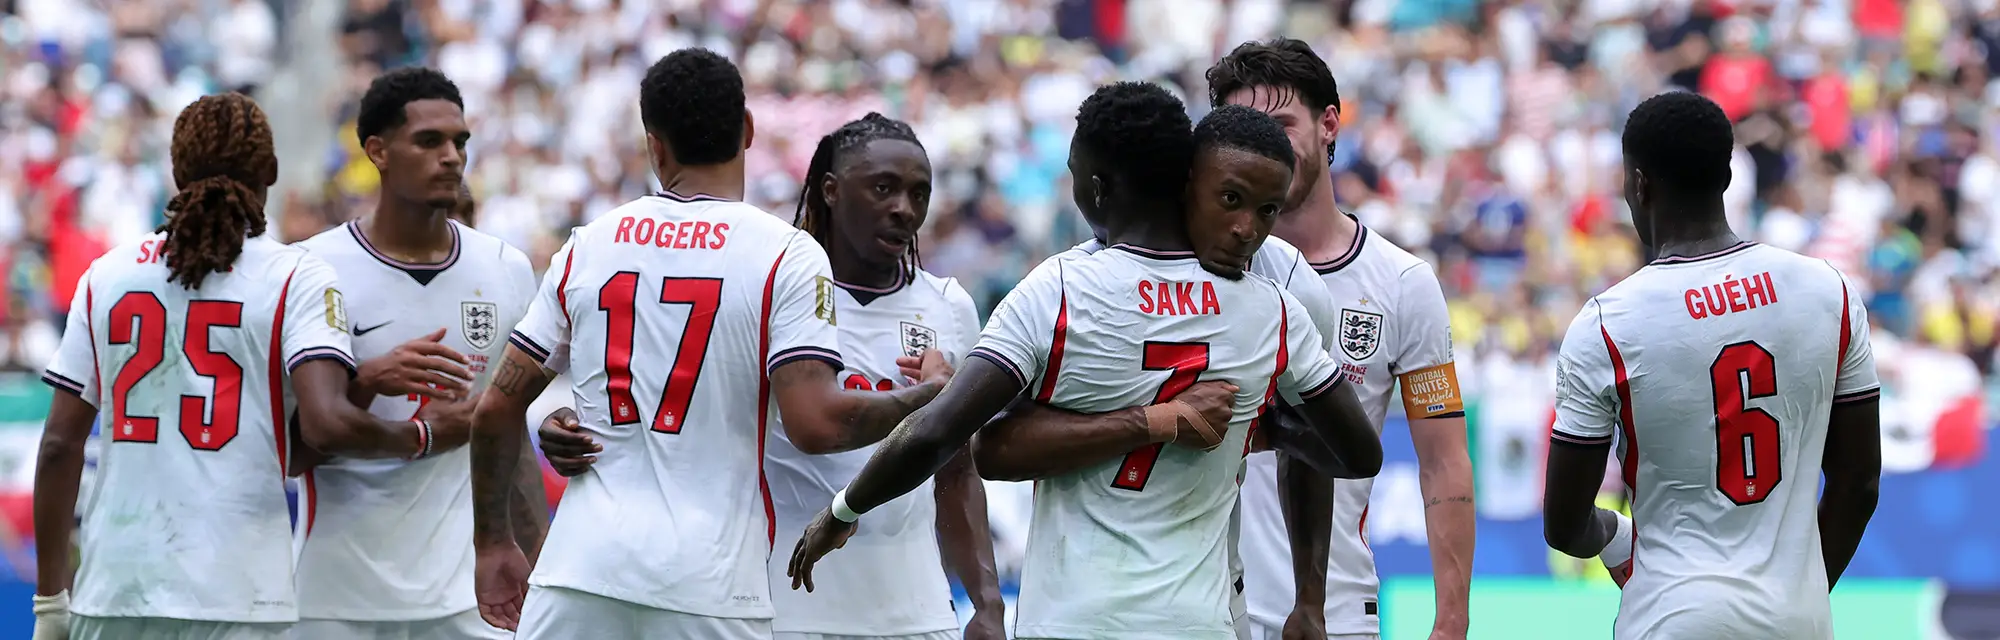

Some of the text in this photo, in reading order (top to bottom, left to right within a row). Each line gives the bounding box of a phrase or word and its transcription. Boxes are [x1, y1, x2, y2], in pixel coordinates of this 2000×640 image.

[615, 217, 729, 250] ROGERS
[1139, 280, 1221, 316] SAKA
[1685, 272, 1778, 320] GUÉHI
[598, 270, 724, 434] 17
[1341, 363, 1367, 375] FRANCE
[108, 291, 244, 452] 25
[1408, 369, 1446, 384] FOOTBALL
[1410, 377, 1450, 395] UNITES
[1412, 389, 1453, 406] the World
[1110, 341, 1210, 491] 7
[1710, 340, 1782, 506] 6
